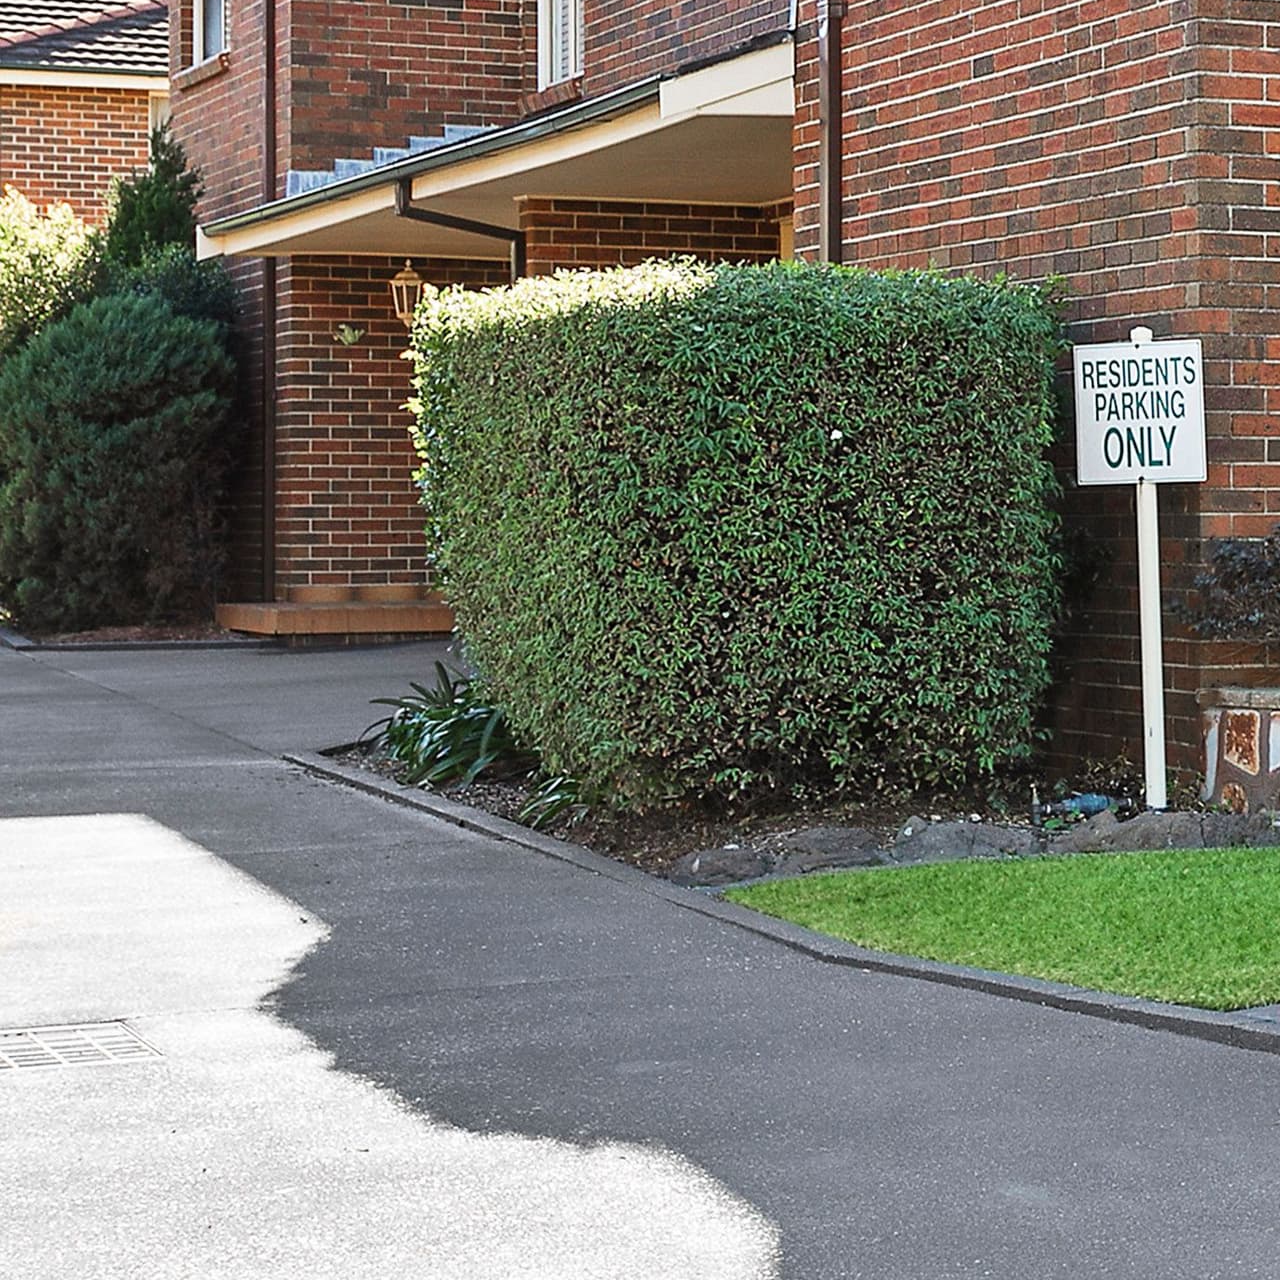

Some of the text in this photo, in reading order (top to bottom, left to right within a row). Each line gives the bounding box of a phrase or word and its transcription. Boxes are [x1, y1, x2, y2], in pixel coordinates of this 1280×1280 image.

[1082, 356, 1196, 389] RESIDENTS
[1095, 390, 1185, 422] PARKING
[1103, 425, 1177, 469] ONLY
